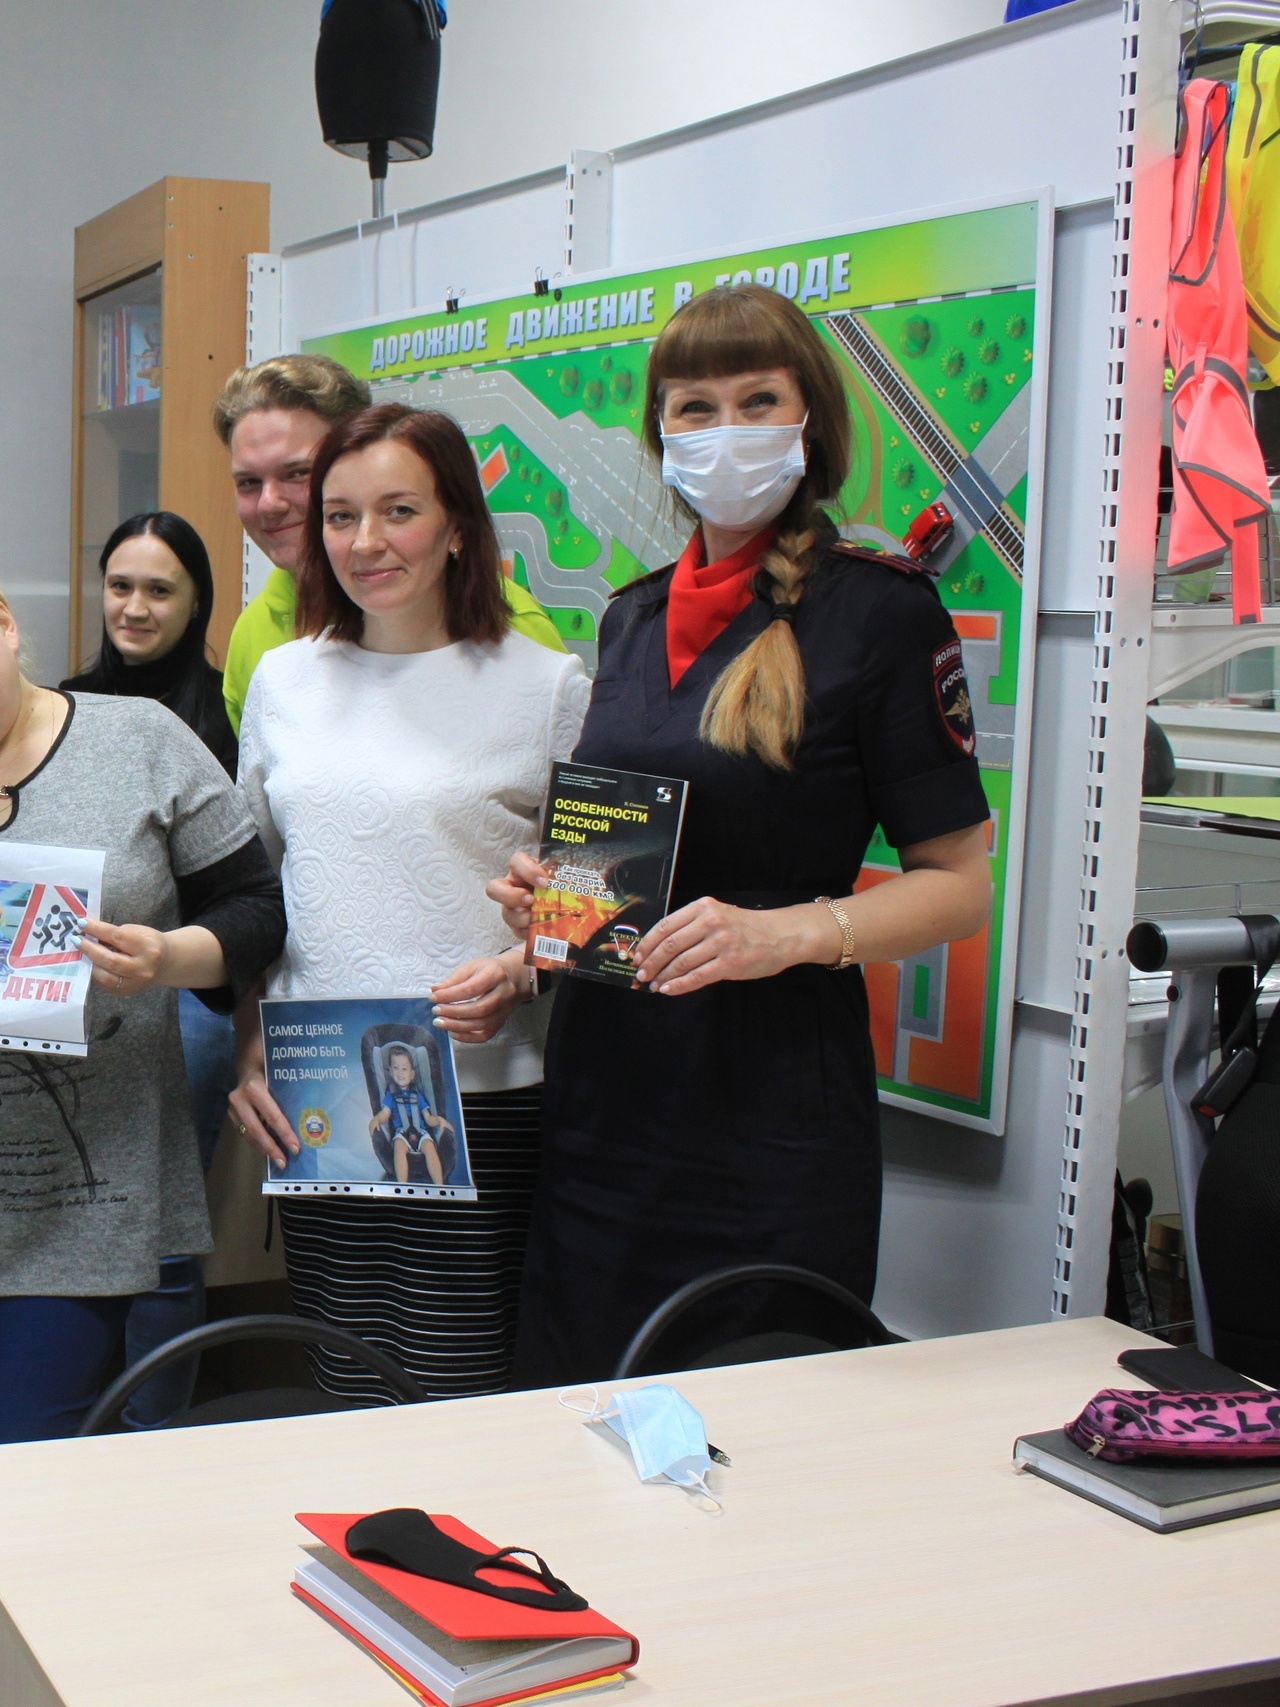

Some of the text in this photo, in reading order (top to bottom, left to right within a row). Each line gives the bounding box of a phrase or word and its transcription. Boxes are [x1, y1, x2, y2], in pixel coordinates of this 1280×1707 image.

[370, 317, 488, 372] ДОРОЖНОЕ
[505, 287, 654, 350] ДВИЖЕНИЕ
[554, 798, 648, 823] ОСОБЕННОСТИ
[552, 813, 610, 832] РУССКОЙ
[550, 828, 586, 843] ЕЗДЫ
[556, 872, 572, 881] без
[563, 866, 600, 877] Как проехать
[547, 881, 614, 901] 500 000 км?
[2, 976, 72, 1003] ДЕТИ!
[269, 1024, 344, 1038] САМОЕ ЦЕННОЕ
[272, 1046, 346, 1060] ДОЛЖНО БЫТЬ
[274, 1065, 349, 1082] ПОД ЗАЩИТОЙ
